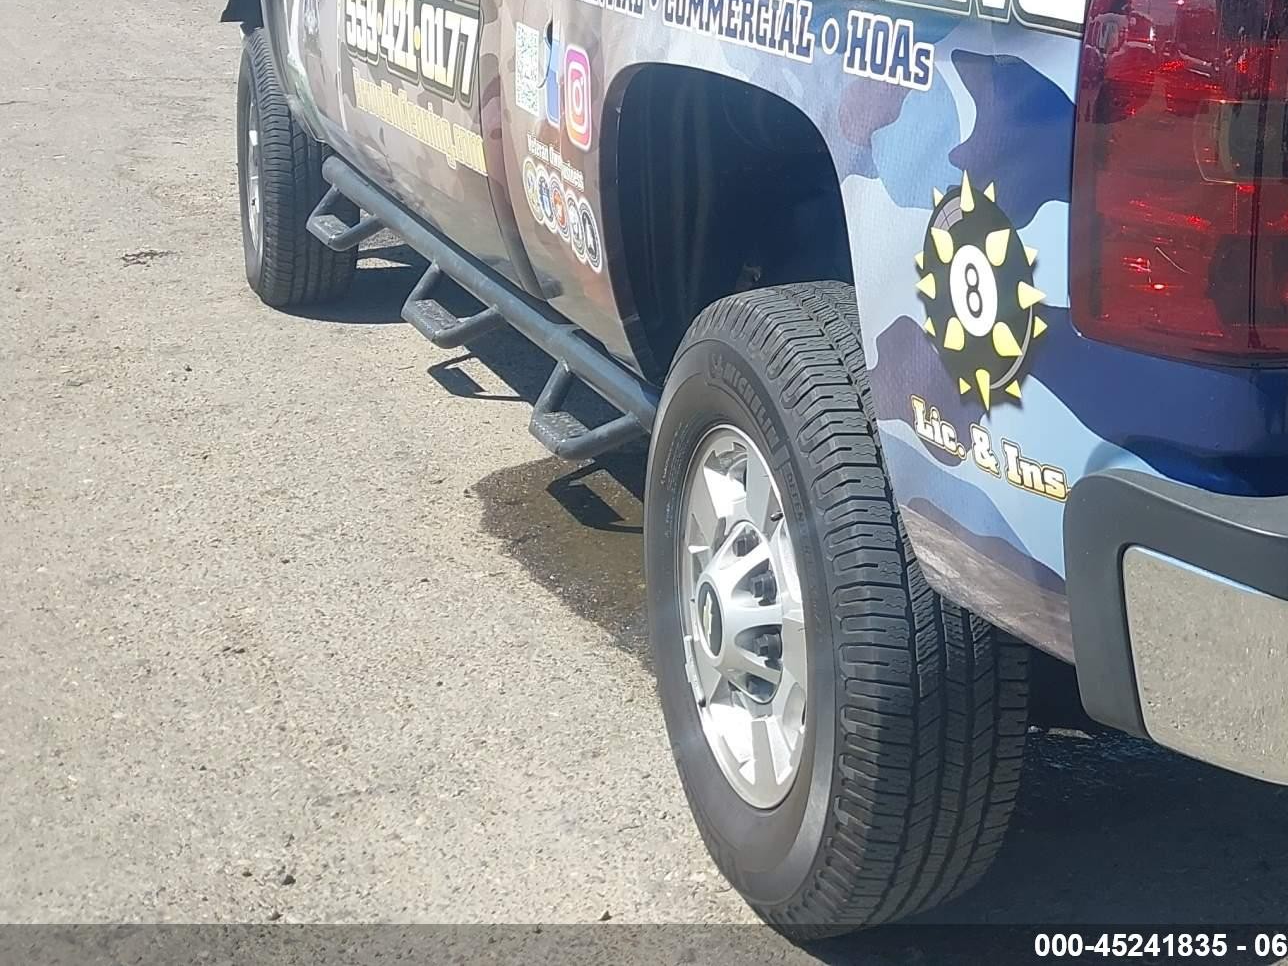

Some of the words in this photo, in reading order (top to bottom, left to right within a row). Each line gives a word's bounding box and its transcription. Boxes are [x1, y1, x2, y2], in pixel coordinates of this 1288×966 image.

[846, 11, 932, 89] HOAs
[911, 395, 967, 461] Lic.
[969, 423, 1001, 478] &
